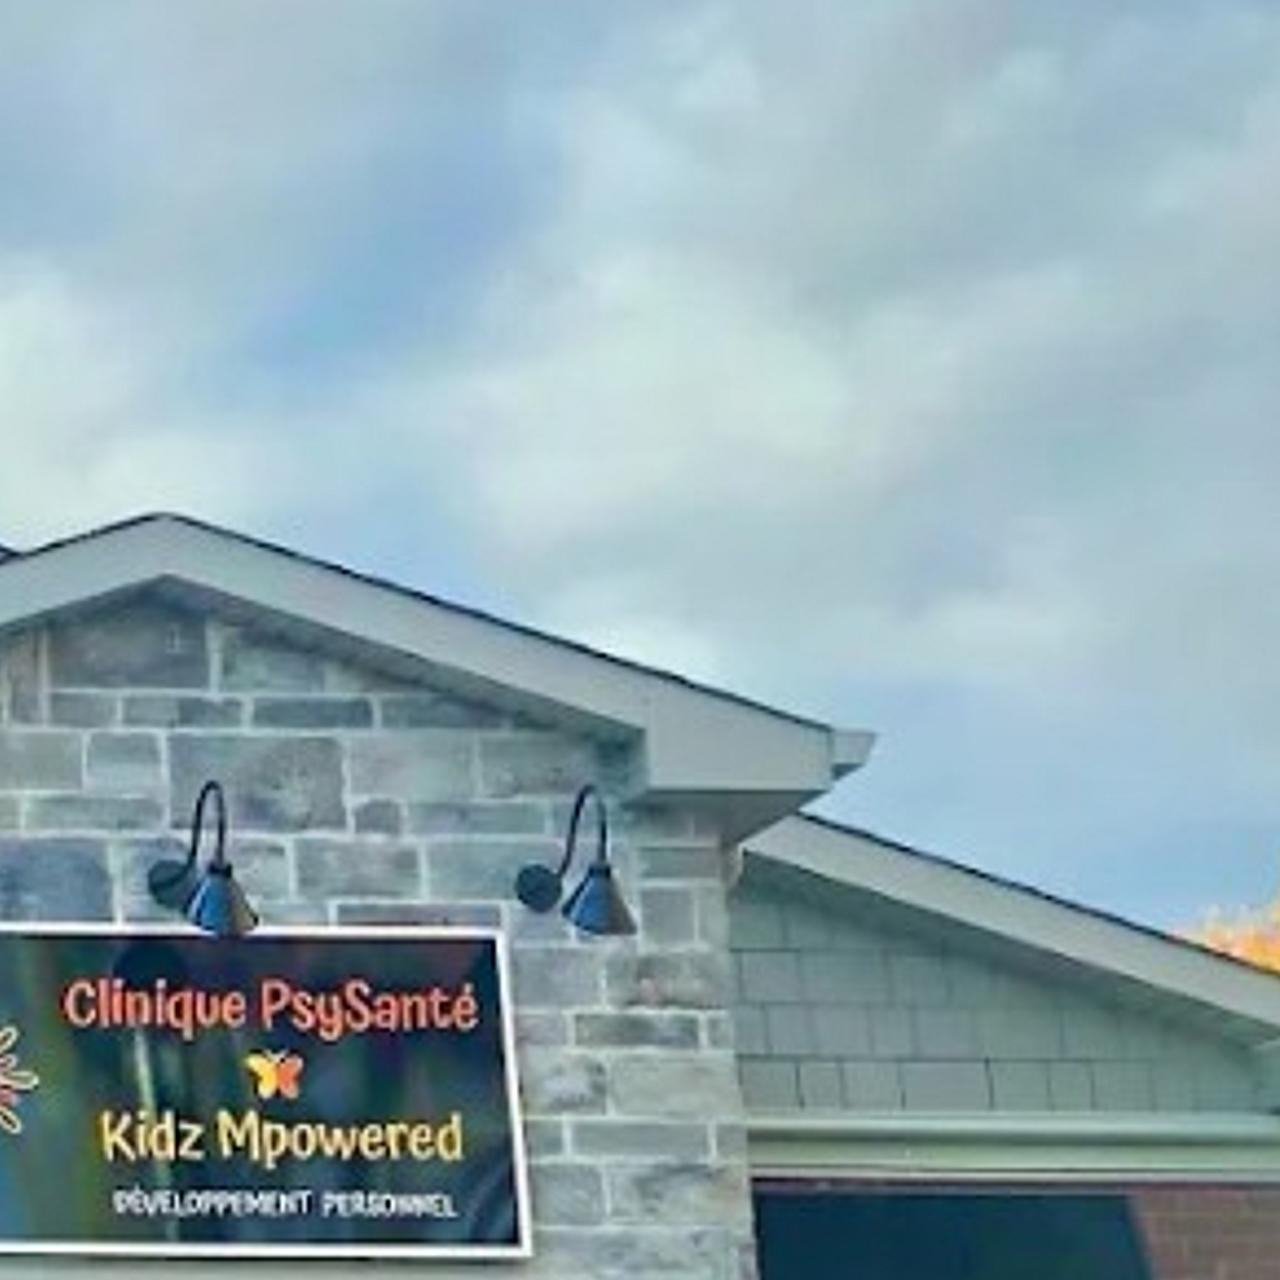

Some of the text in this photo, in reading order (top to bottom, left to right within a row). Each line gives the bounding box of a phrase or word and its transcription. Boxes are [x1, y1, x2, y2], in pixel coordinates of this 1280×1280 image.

[64, 979, 480, 1041] Clinique PsySanté
[100, 1111, 463, 1169] Kidz Mpowered
[113, 1186, 458, 1218] DÉVELOPPEMENT PERSONNEL
